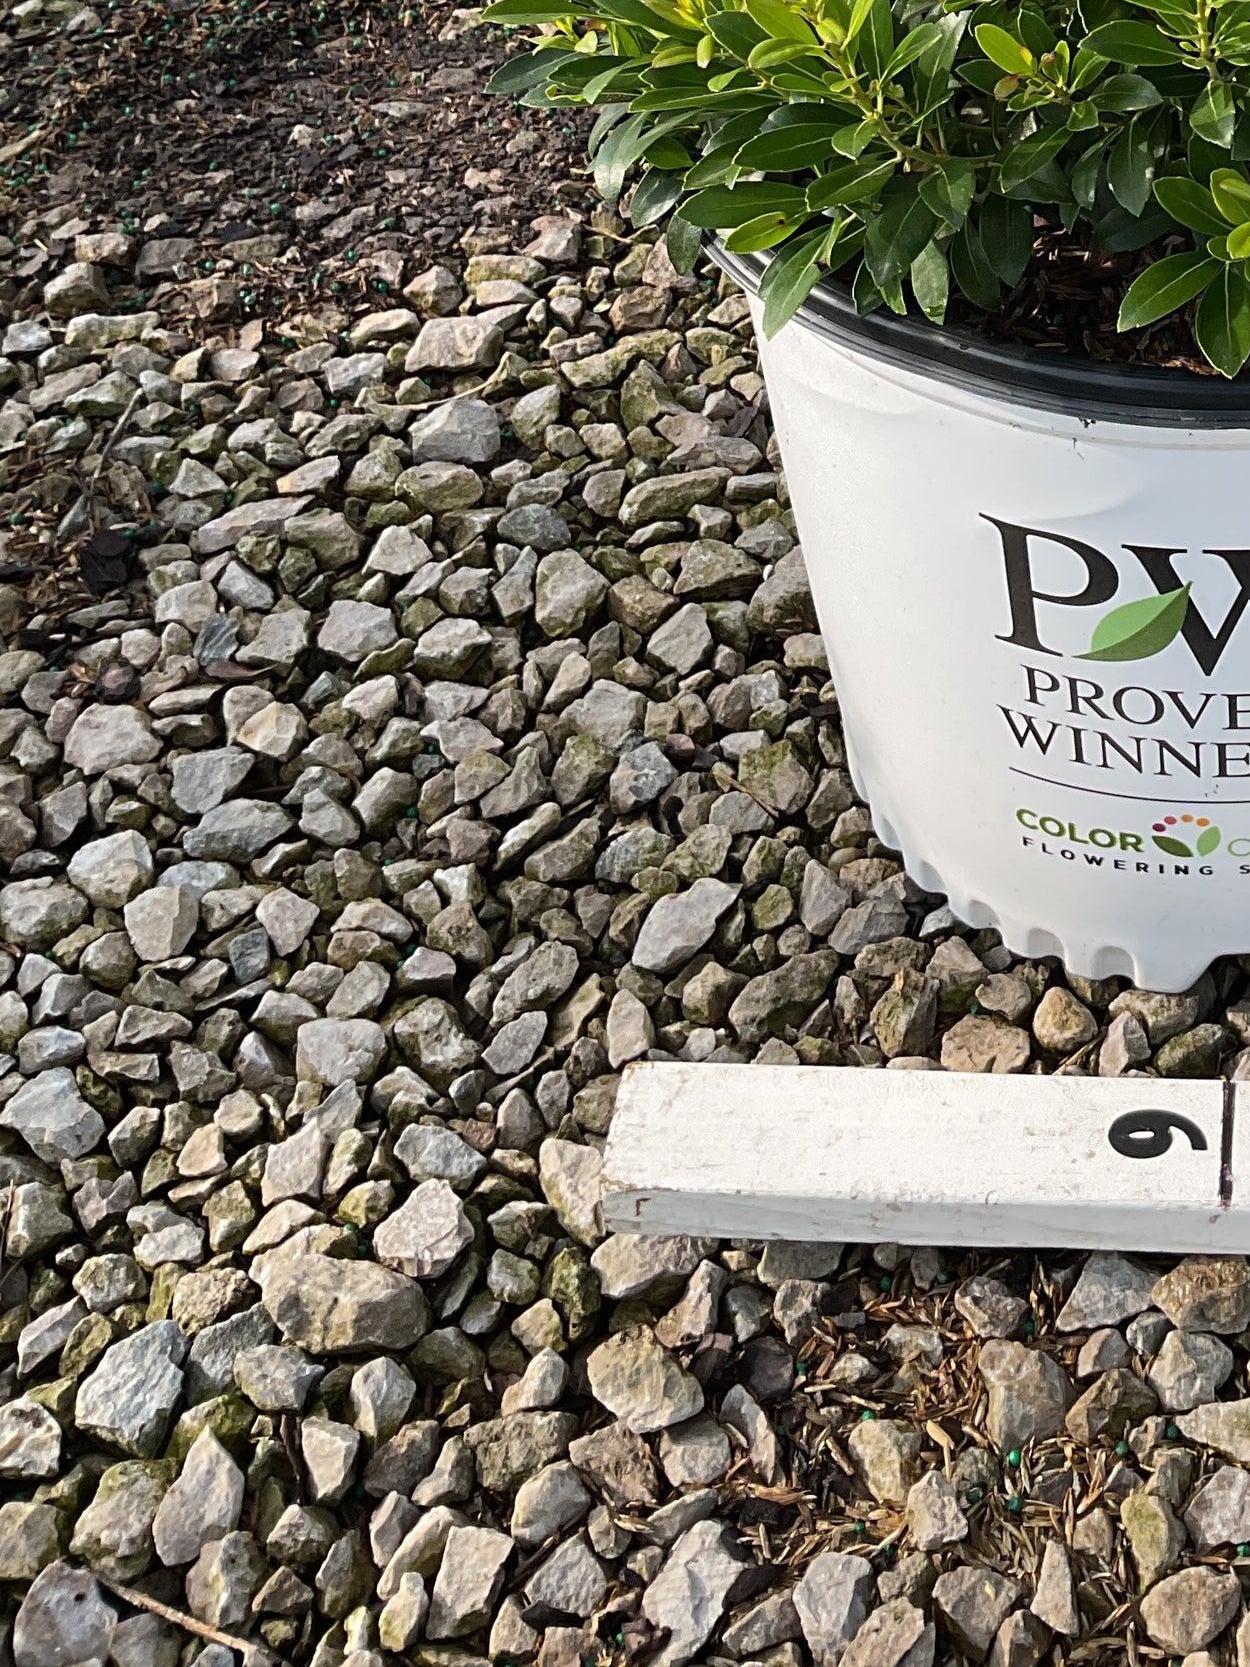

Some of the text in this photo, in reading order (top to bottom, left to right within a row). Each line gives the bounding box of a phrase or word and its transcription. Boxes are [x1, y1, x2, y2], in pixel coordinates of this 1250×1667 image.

[1016, 807, 1144, 854] COLOR
[1021, 836, 1213, 877] FLOWERING
[1108, 1109, 1207, 1159] 6
